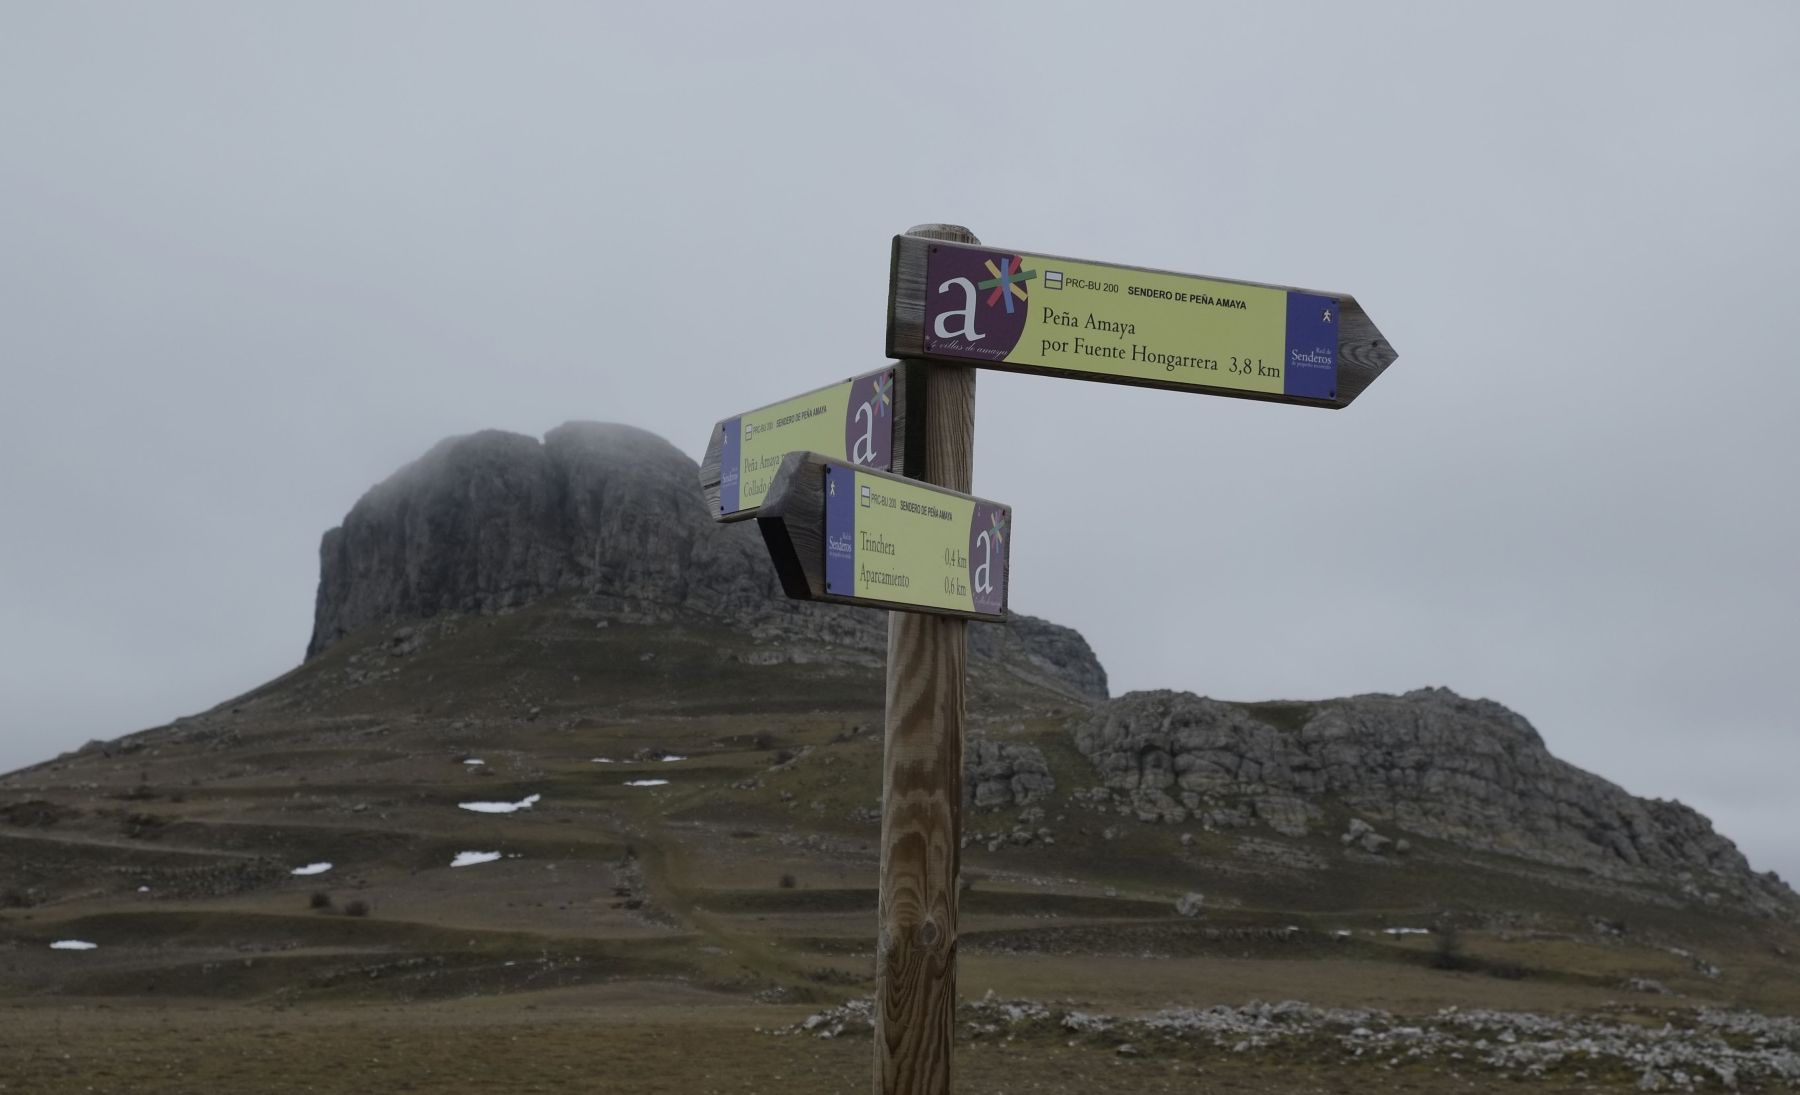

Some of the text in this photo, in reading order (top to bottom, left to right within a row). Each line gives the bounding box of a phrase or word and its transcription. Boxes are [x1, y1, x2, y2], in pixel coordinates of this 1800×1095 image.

[934, 276, 986, 342] a
[1065, 277, 1247, 310] PRC-BU 200 SENDERO DE PEÑA AMAYA
[1042, 307, 1136, 339] Peña Amaya
[1041, 337, 1281, 378] por Fuente Hongarrera 3,8 km
[1291, 348, 1332, 365] Senderos
[776, 415, 795, 428] SENDERO
[795, 412, 801, 422] DE
[812, 405, 827, 417] AMAYA
[852, 401, 877, 464] a
[743, 457, 758, 473] Peña
[759, 454, 780, 472] Amaya
[743, 478, 767, 497] Collado
[871, 493, 953, 521] PRC-BU 200 SENDERO DE PEÑA AMAYA
[829, 535, 852, 553] Senderos
[860, 530, 896, 556] Trinchera
[944, 547, 956, 567] 0,4
[956, 549, 967, 569] km
[974, 530, 993, 595] a
[859, 562, 967, 597] Aparcamiento 0,6 km
